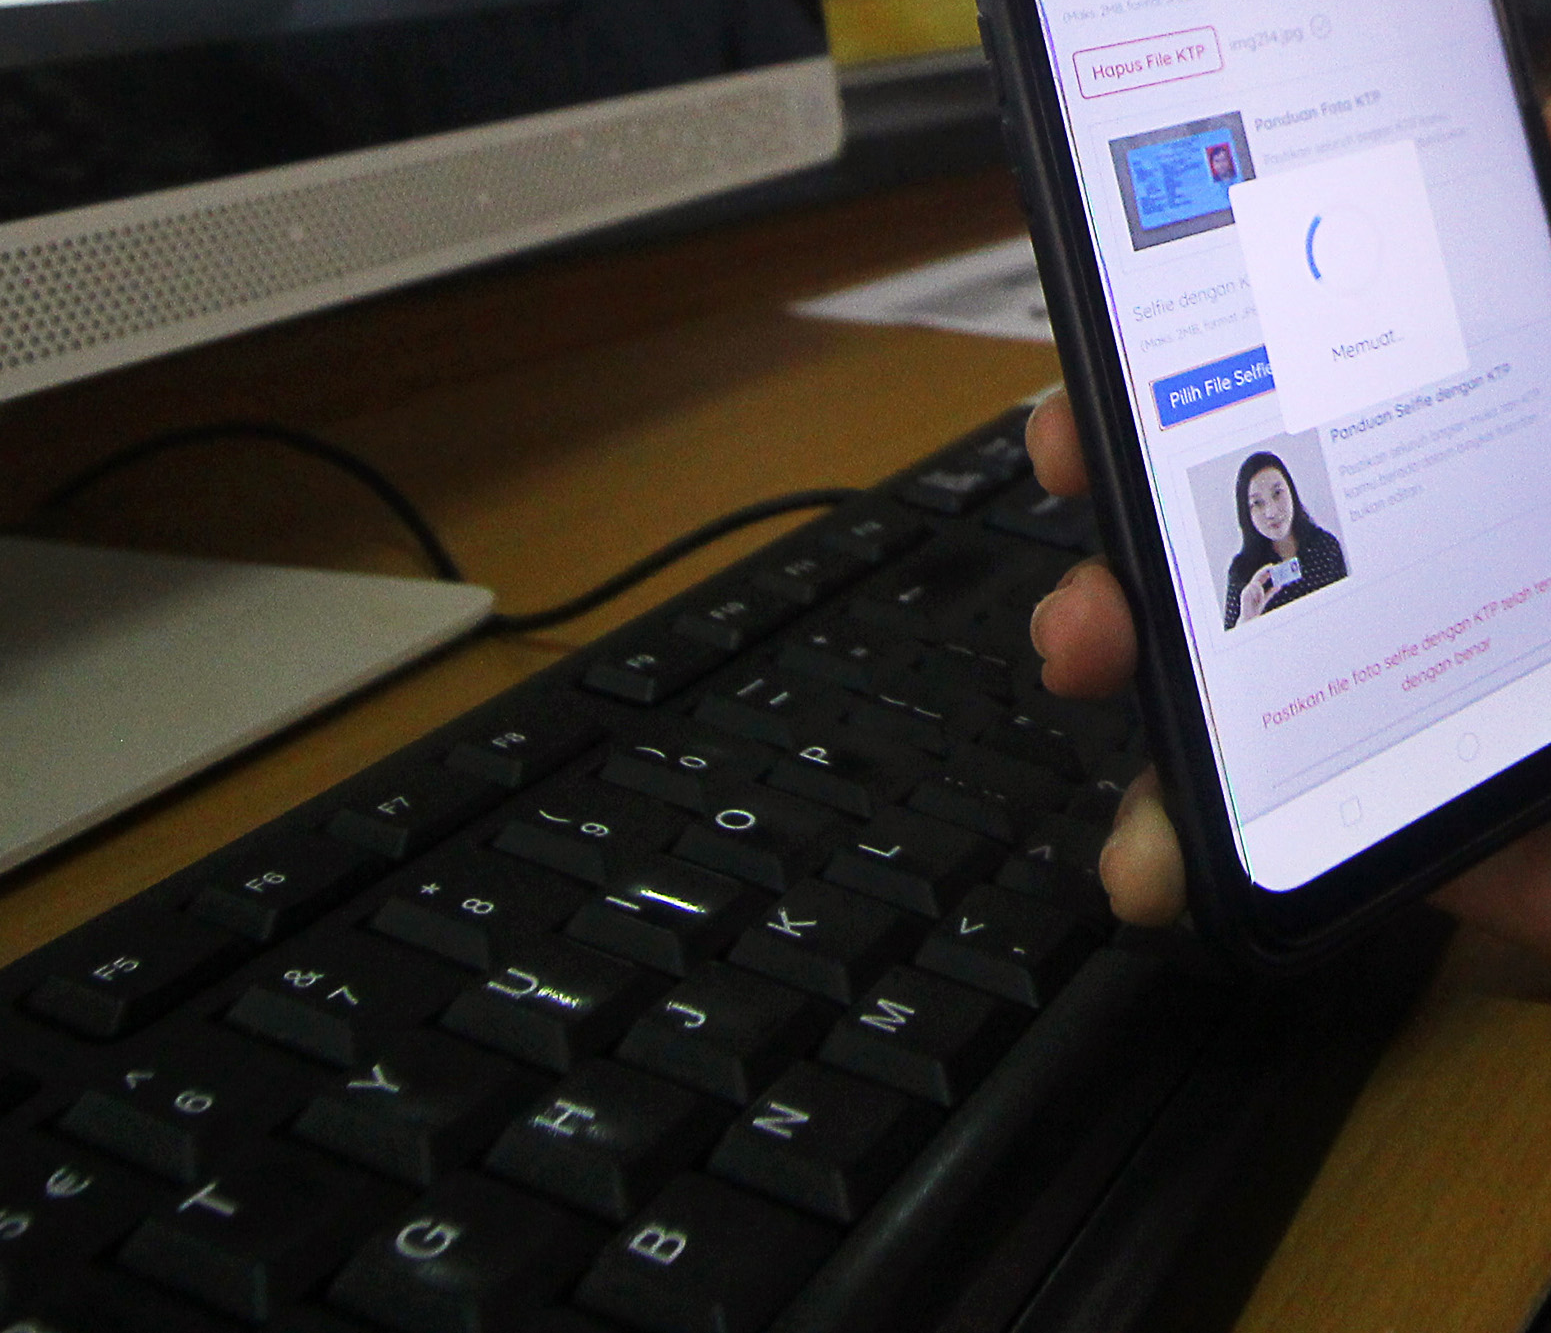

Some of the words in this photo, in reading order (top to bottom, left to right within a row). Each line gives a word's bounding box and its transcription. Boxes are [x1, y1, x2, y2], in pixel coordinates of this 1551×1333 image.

[1092, 59, 1143, 81] Hapus
[1146, 52, 1172, 69] File
[1176, 43, 1206, 63] KTP
[1253, 107, 1318, 132] Panduan
[1133, 297, 1175, 322] Selfie
[1178, 282, 1236, 309] dengan
[1169, 386, 1202, 409] Pilih
[1204, 376, 1231, 398] File
[1330, 410, 1393, 443] Panduan
[1395, 395, 1433, 418] Selfie
[1261, 689, 1326, 729] Pastikan
[1327, 677, 1350, 698] file
[1351, 660, 1383, 686] foto
[1383, 640, 1420, 670] selfie
[1420, 617, 1473, 651] dengan
[1400, 657, 1453, 692] dengan
[1453, 636, 1492, 666] benar
[377, 795, 410, 816] F7
[246, 871, 286, 893] F6
[461, 897, 494, 916] 8
[766, 906, 817, 938] K
[94, 956, 140, 982] F5
[665, 1000, 707, 1029] J
[859, 998, 916, 1034] M
[346, 1063, 401, 1094] Y
[532, 1097, 596, 1137] H
[751, 1100, 810, 1139] N
[177, 1179, 236, 1217] T
[395, 1217, 460, 1260] G
[628, 1223, 687, 1266] B
